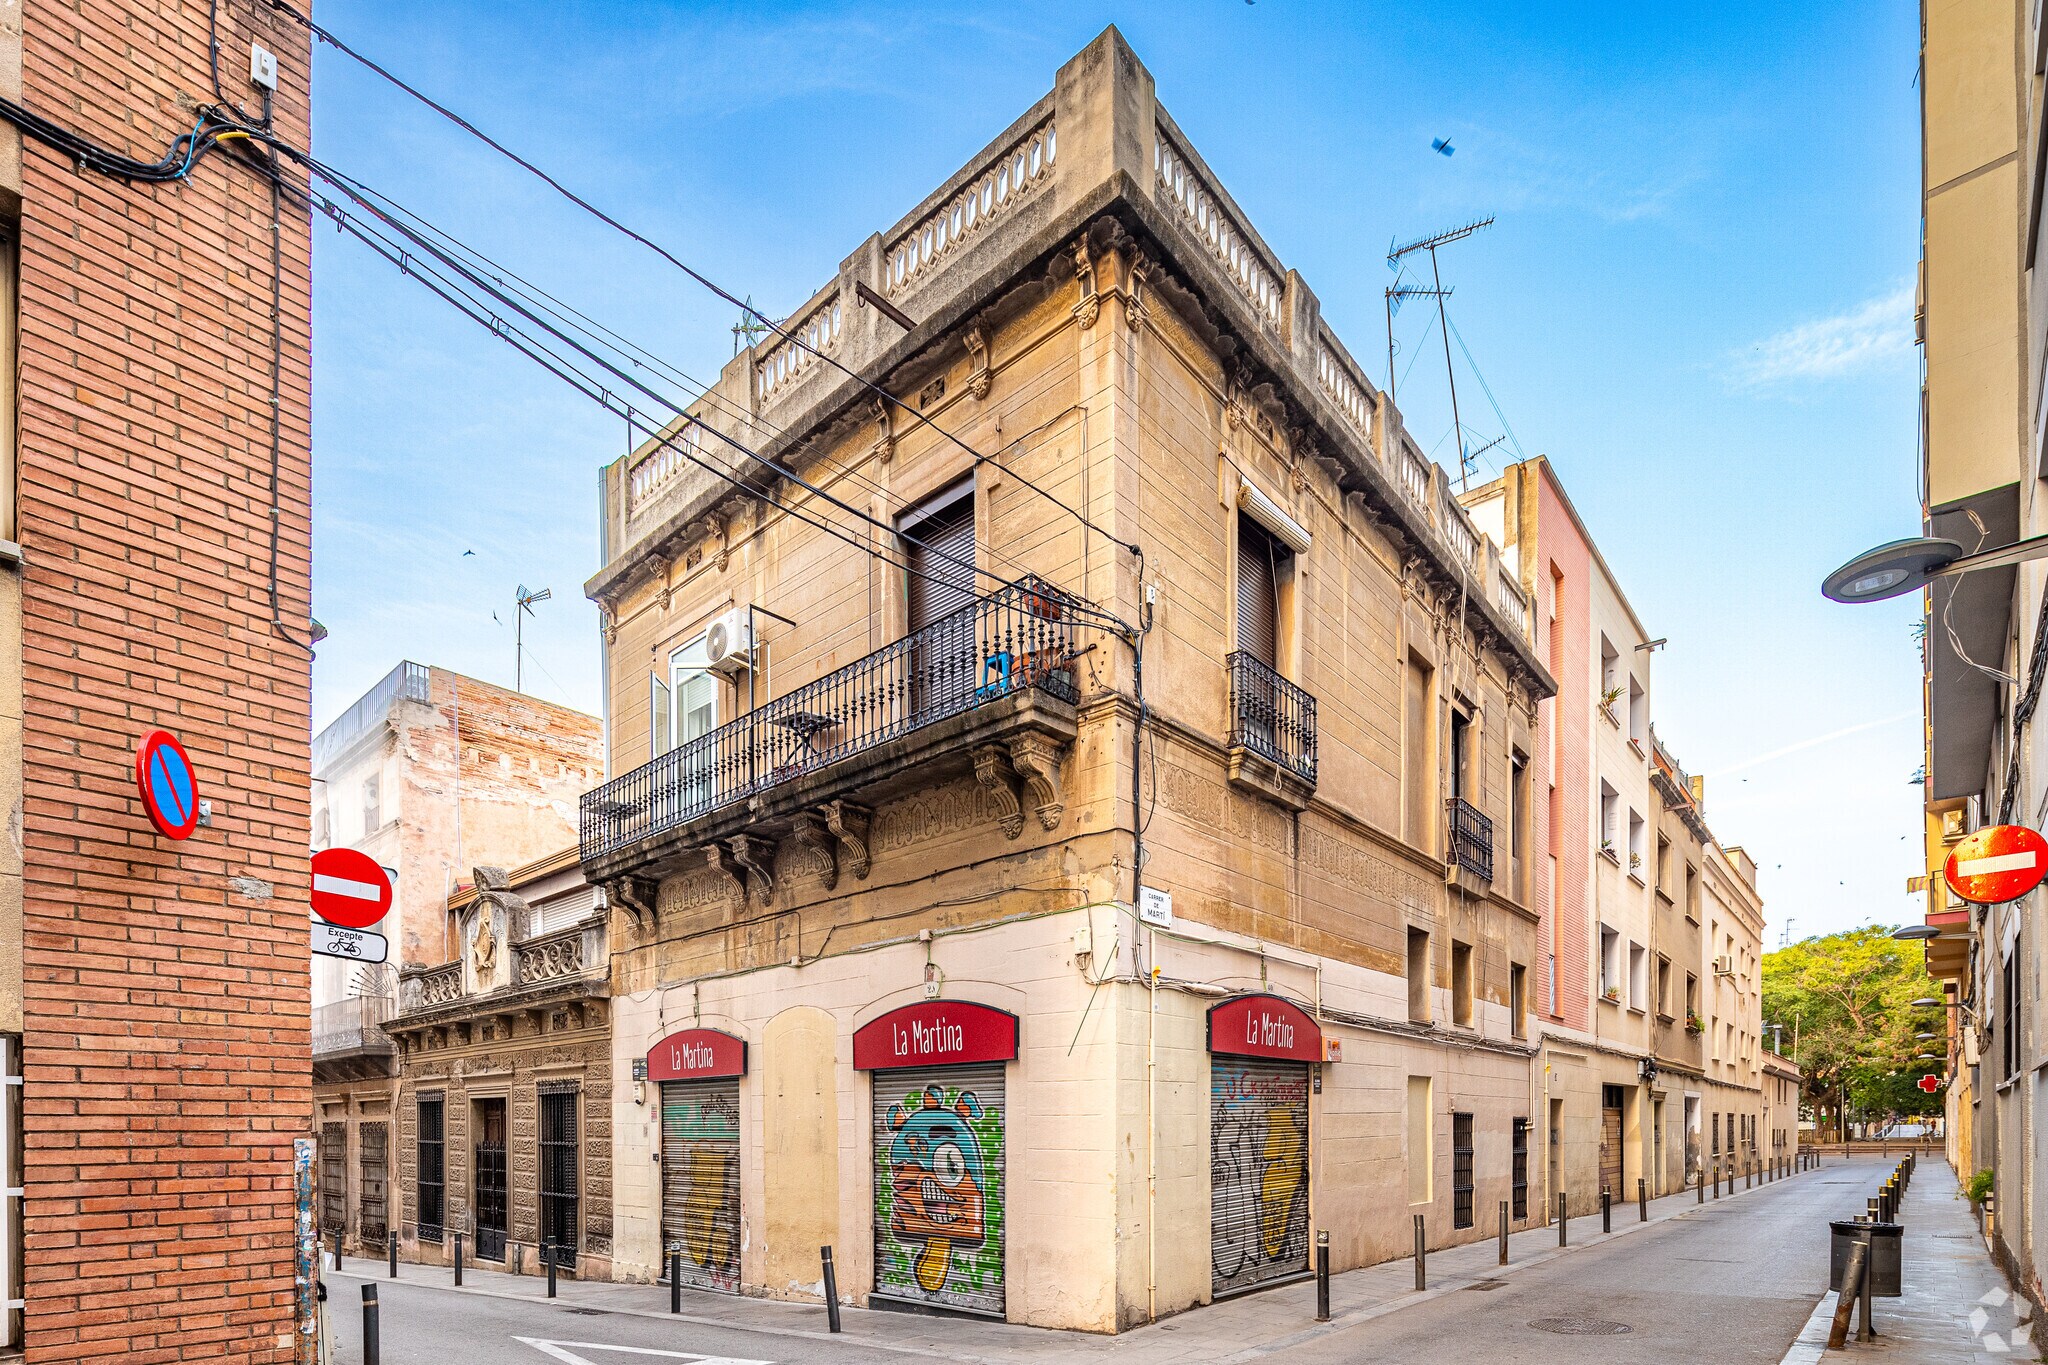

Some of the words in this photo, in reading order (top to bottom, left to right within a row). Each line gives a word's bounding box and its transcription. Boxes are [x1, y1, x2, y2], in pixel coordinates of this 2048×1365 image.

[1148, 893, 1164, 902] CARRER
[1147, 909, 1166, 920] MARTÍ
[328, 927, 363, 941] Excepte
[893, 1022, 908, 1056] La
[912, 1016, 963, 1055] Martina
[1246, 1010, 1258, 1045] La
[1261, 1012, 1294, 1049] Martina
[671, 1044, 681, 1071] La
[682, 1041, 714, 1069] Martina
